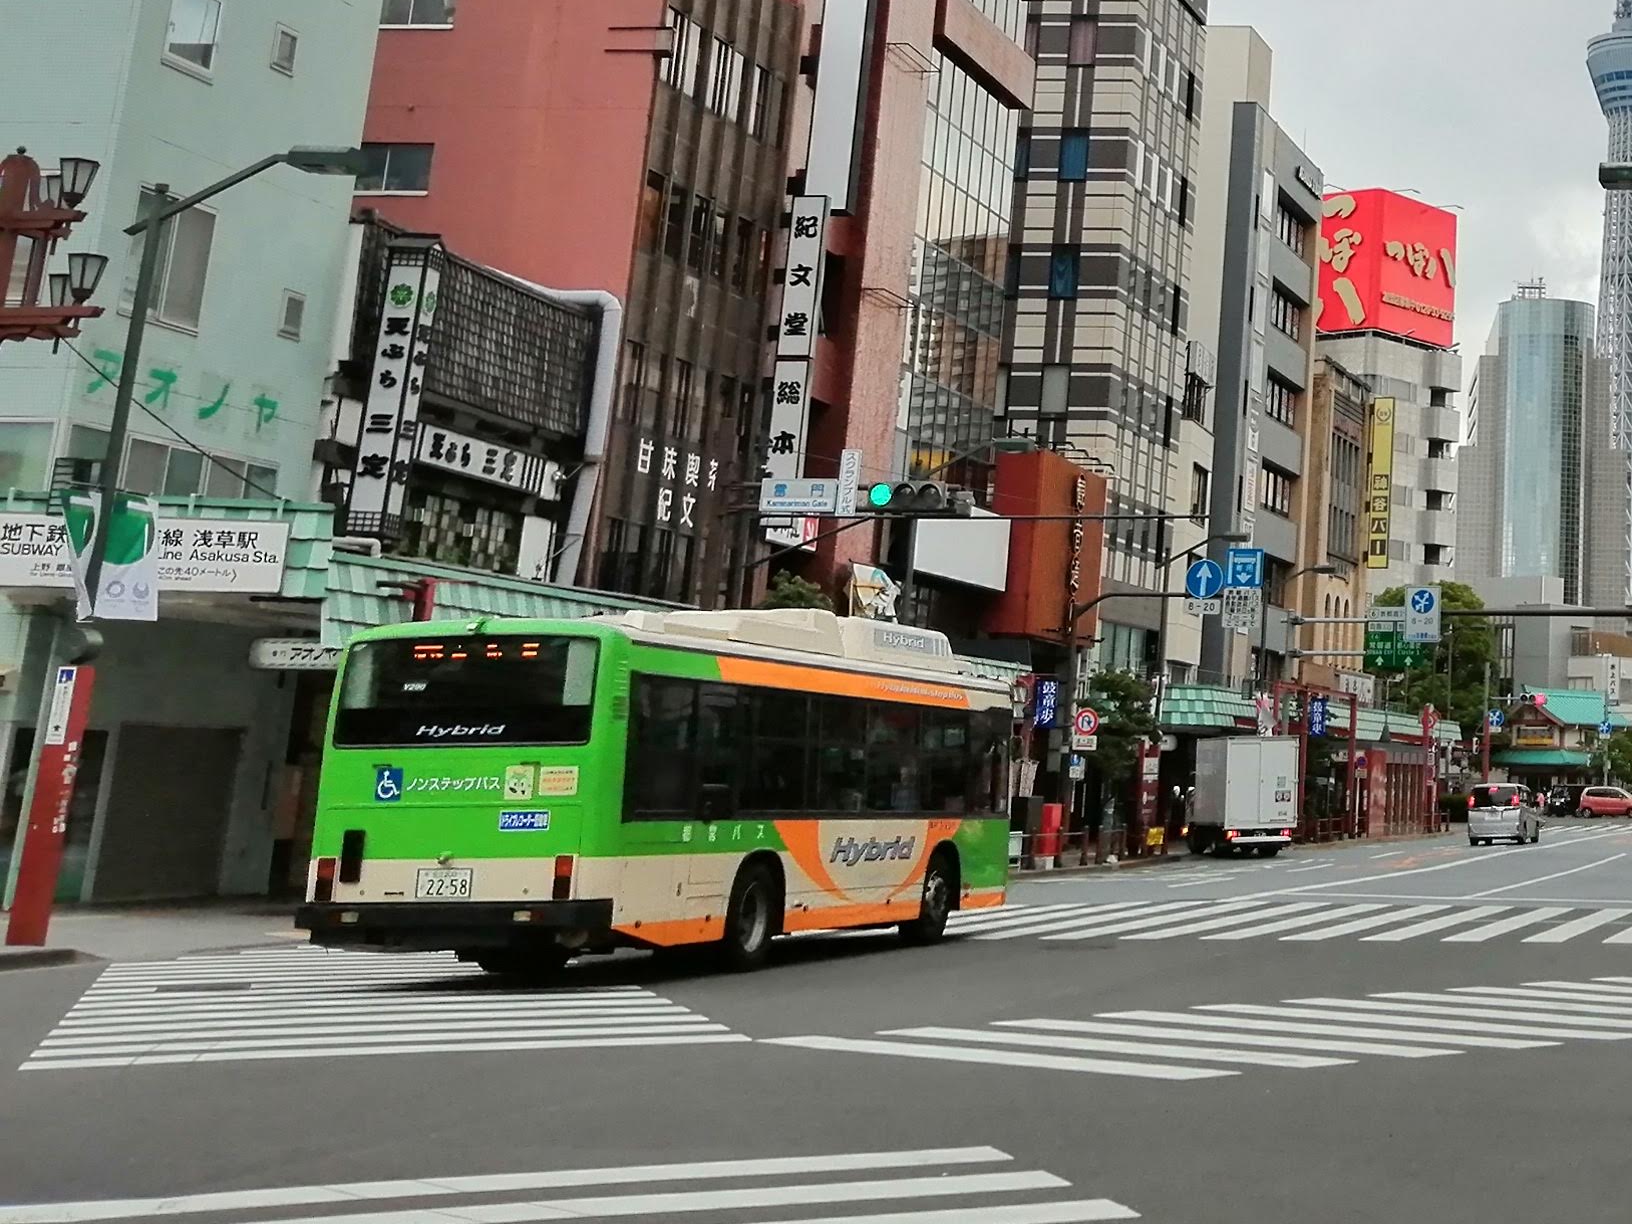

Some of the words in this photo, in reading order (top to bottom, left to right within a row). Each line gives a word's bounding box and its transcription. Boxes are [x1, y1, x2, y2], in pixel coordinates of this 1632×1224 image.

[86, 348, 279, 433] アオノヤ
[1371, 474, 1389, 556] 神谷バー
[1, 523, 68, 544] 地下鉄
[158, 528, 183, 547] 線
[192, 529, 259, 549] 浅草駅
[0, 542, 63, 556] SUBWAY
[189, 549, 249, 563] Asakusa
[252, 551, 279, 564] Sta.
[883, 632, 925, 649] Hybrid
[415, 724, 506, 738] Hybrid
[406, 775, 500, 792] ノンステップバス
[829, 836, 916, 866] Hybrid
[426, 879, 468, 896] 22-58
